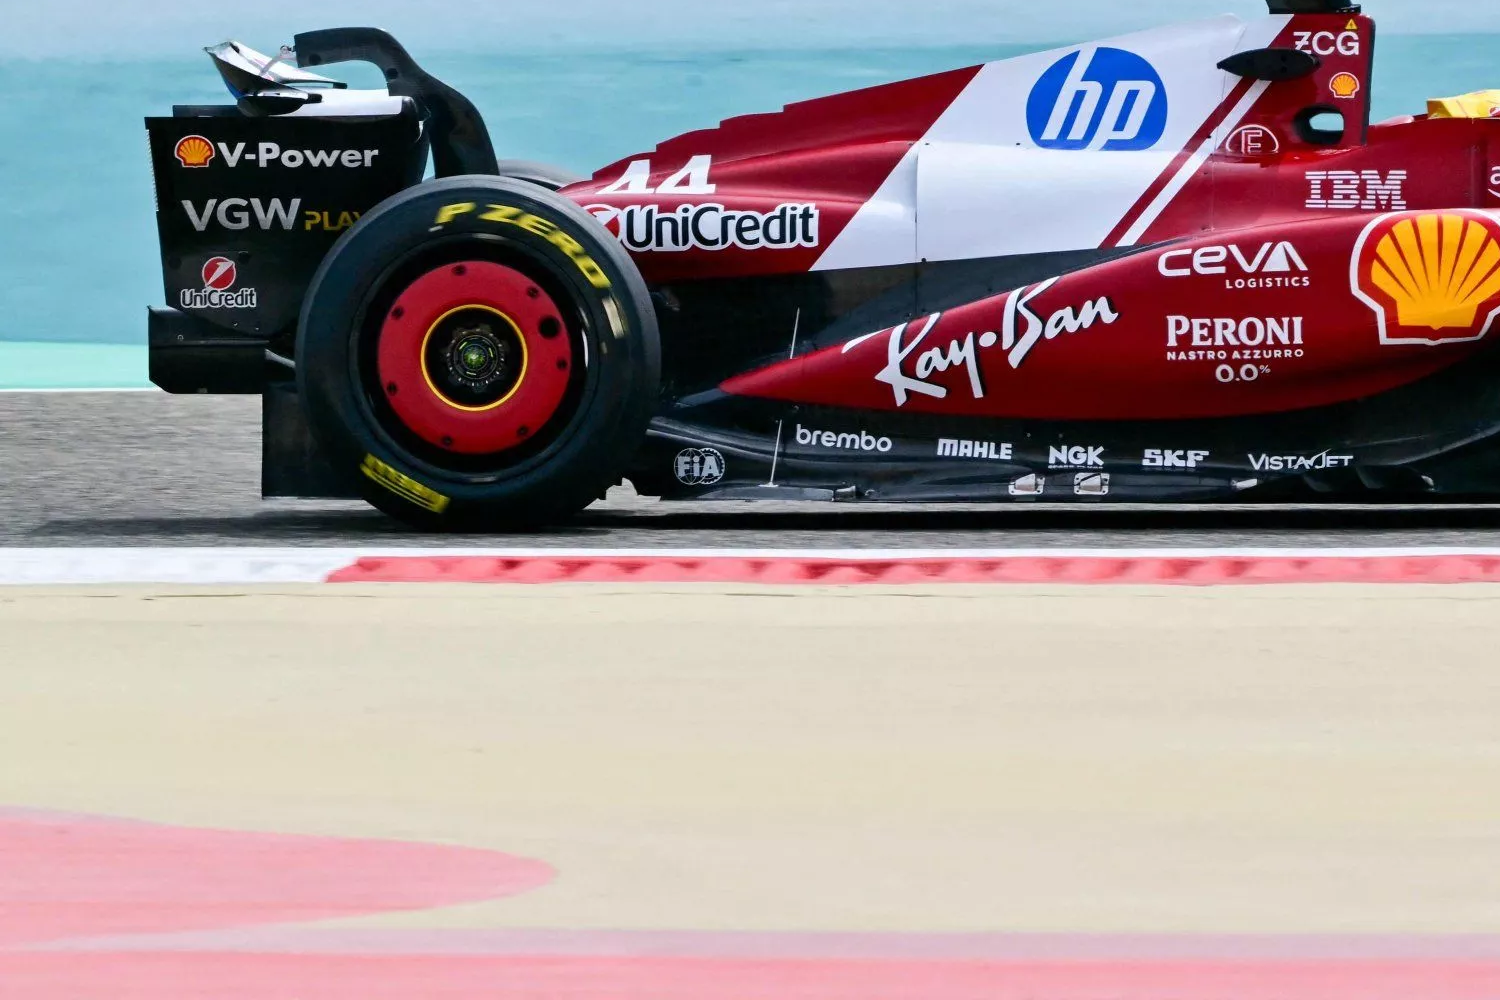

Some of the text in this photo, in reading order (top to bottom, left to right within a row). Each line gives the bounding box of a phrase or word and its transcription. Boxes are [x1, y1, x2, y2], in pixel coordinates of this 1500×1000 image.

[1039, 46, 1157, 151] hp
[217, 142, 379, 168] V-Power
[595, 154, 717, 195] 44
[1305, 169, 1407, 210] IBM
[181, 198, 301, 232] VGW
[625, 204, 816, 250] UniCredit
[434, 202, 612, 289] P ZERO
[1225, 276, 1310, 289] LOGISTICS
[180, 287, 257, 308] UniCredit
[1166, 315, 1304, 347] PERONI
[1166, 349, 1304, 361] NASTRO AZZURRO
[1215, 363, 1271, 383] 0.0%
[796, 424, 893, 452] brembo
[936, 438, 1012, 460] MAHLE
[1048, 445, 1105, 466] NGK
[1141, 448, 1210, 468] SKF
